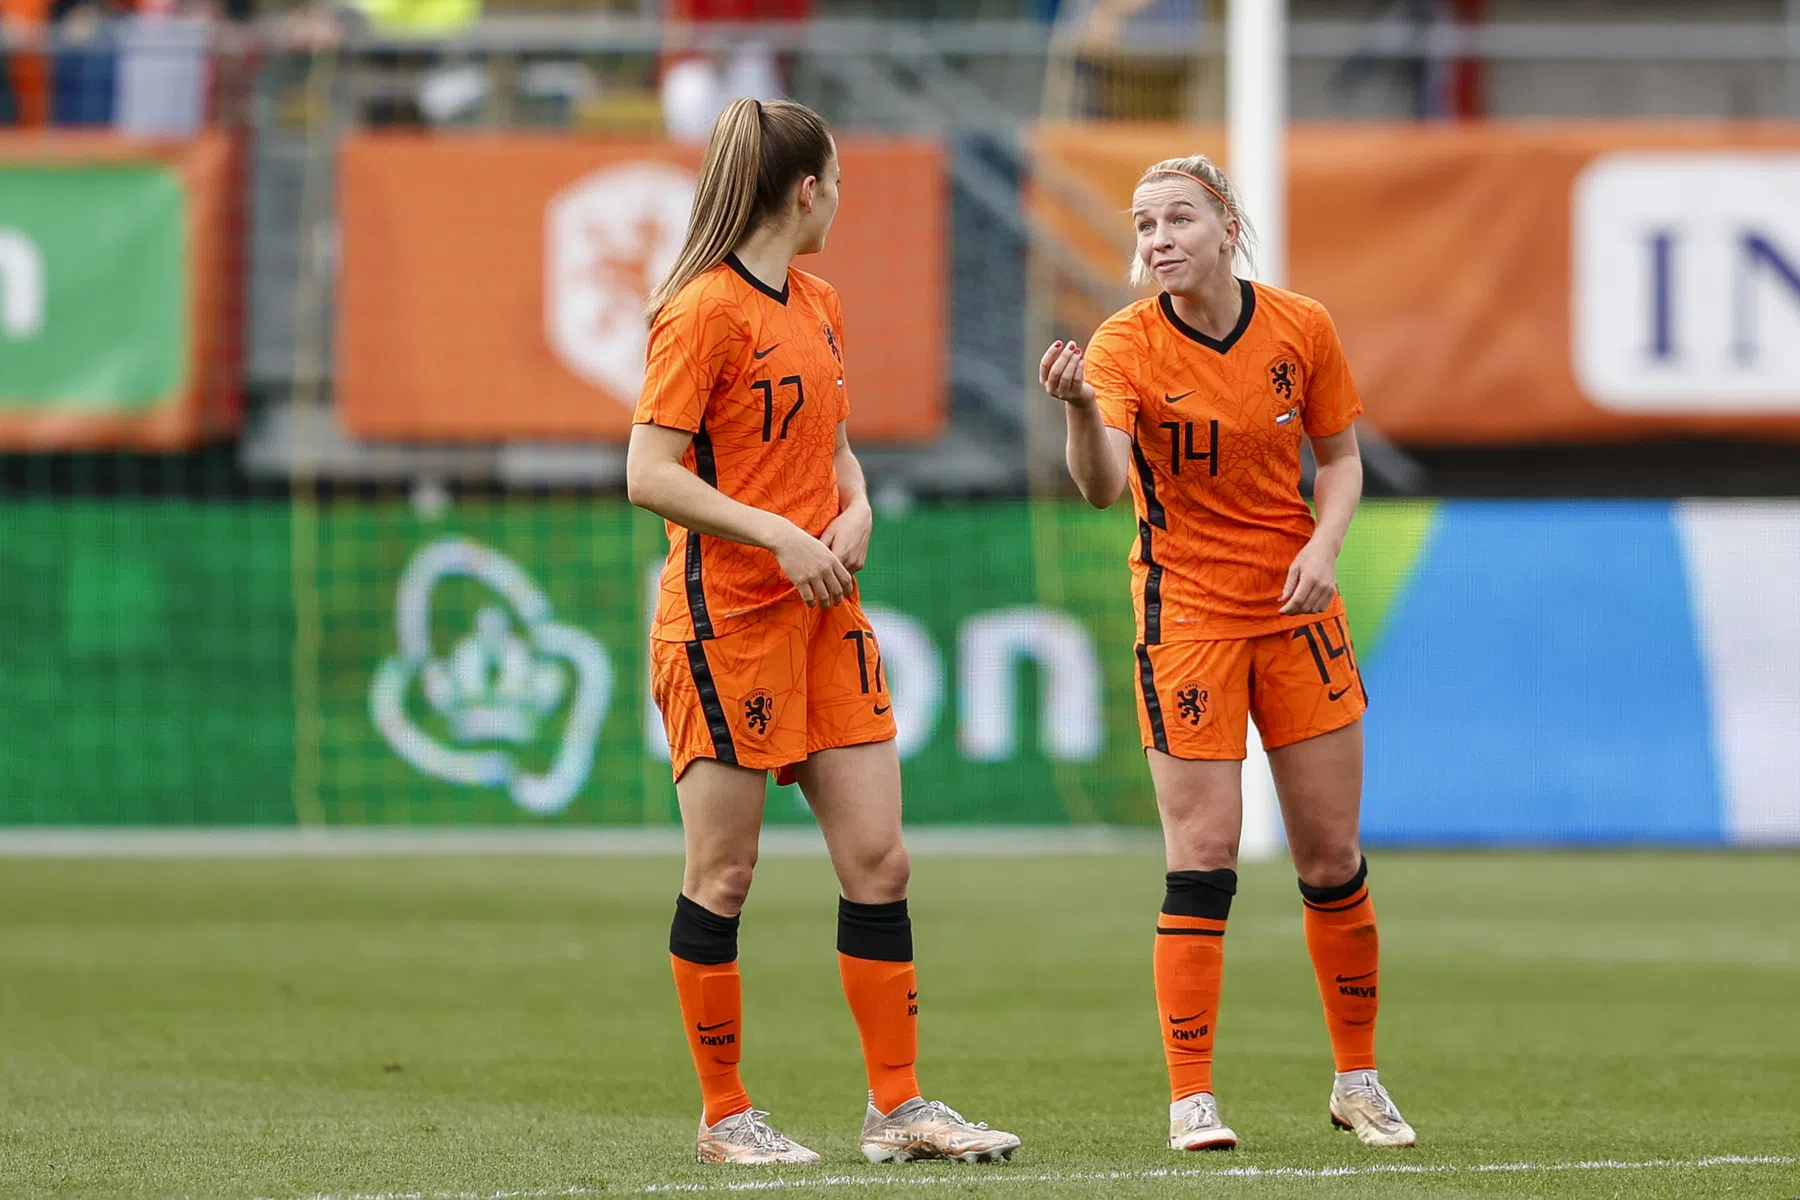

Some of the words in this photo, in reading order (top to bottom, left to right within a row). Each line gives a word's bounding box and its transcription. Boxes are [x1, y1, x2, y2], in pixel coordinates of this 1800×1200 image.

[749, 375, 804, 442] 17
[1157, 419, 1219, 476] 14
[841, 629, 882, 694] 17
[1291, 616, 1355, 685] 14
[1338, 985, 1377, 998] KNVB
[700, 1033, 735, 1046] KNVB
[1172, 1024, 1208, 1040] KNVB
